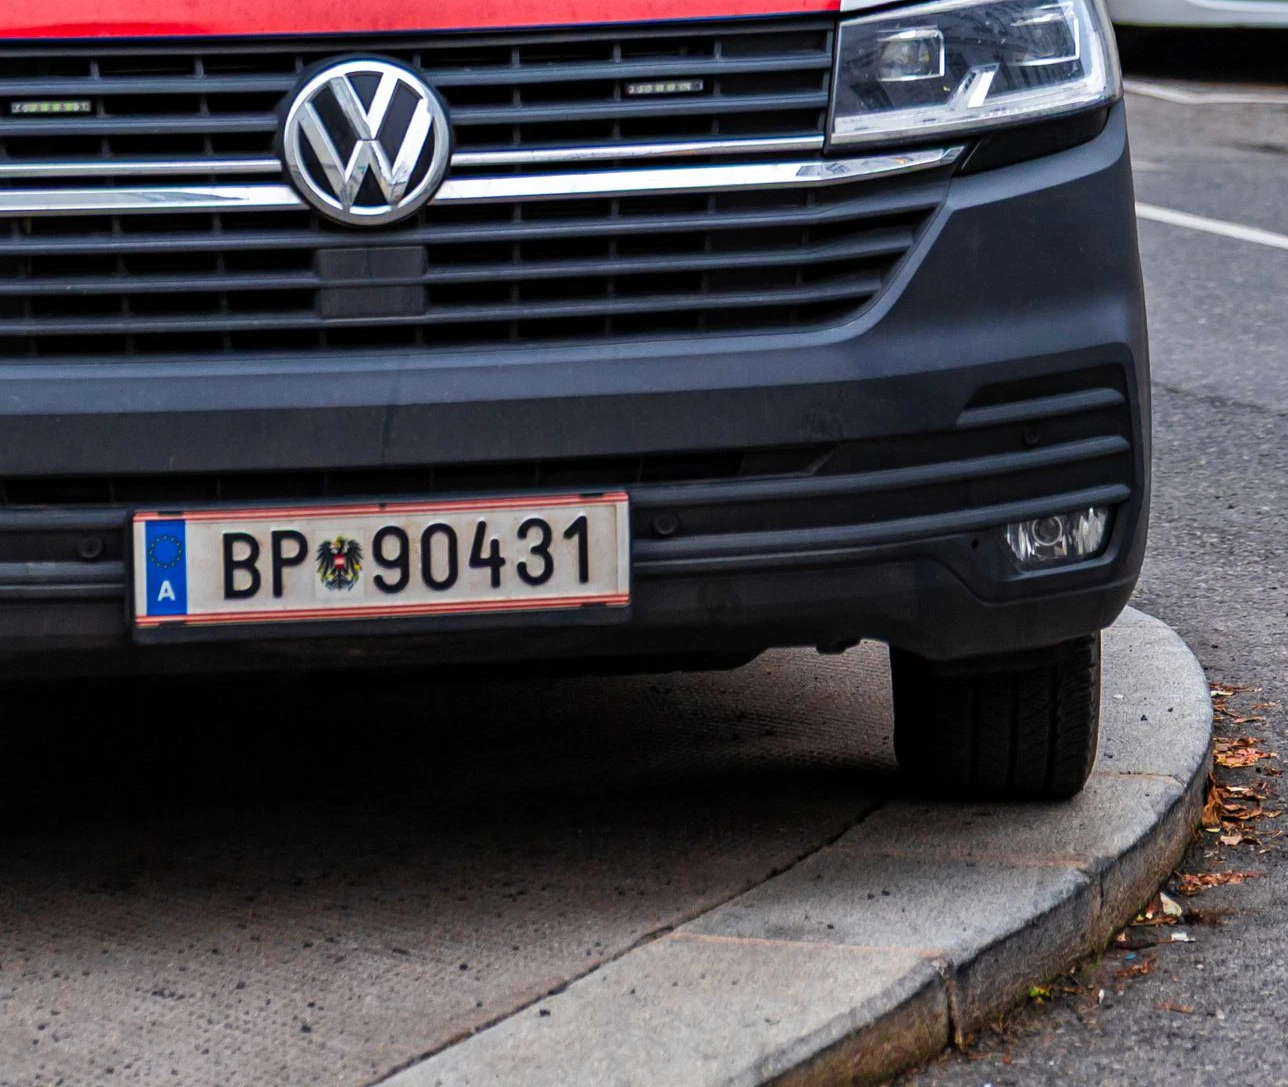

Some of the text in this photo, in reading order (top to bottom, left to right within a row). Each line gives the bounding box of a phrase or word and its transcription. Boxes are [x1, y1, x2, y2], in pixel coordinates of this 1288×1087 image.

[222, 515, 590, 600] BP 90431
[157, 580, 176, 602] A
